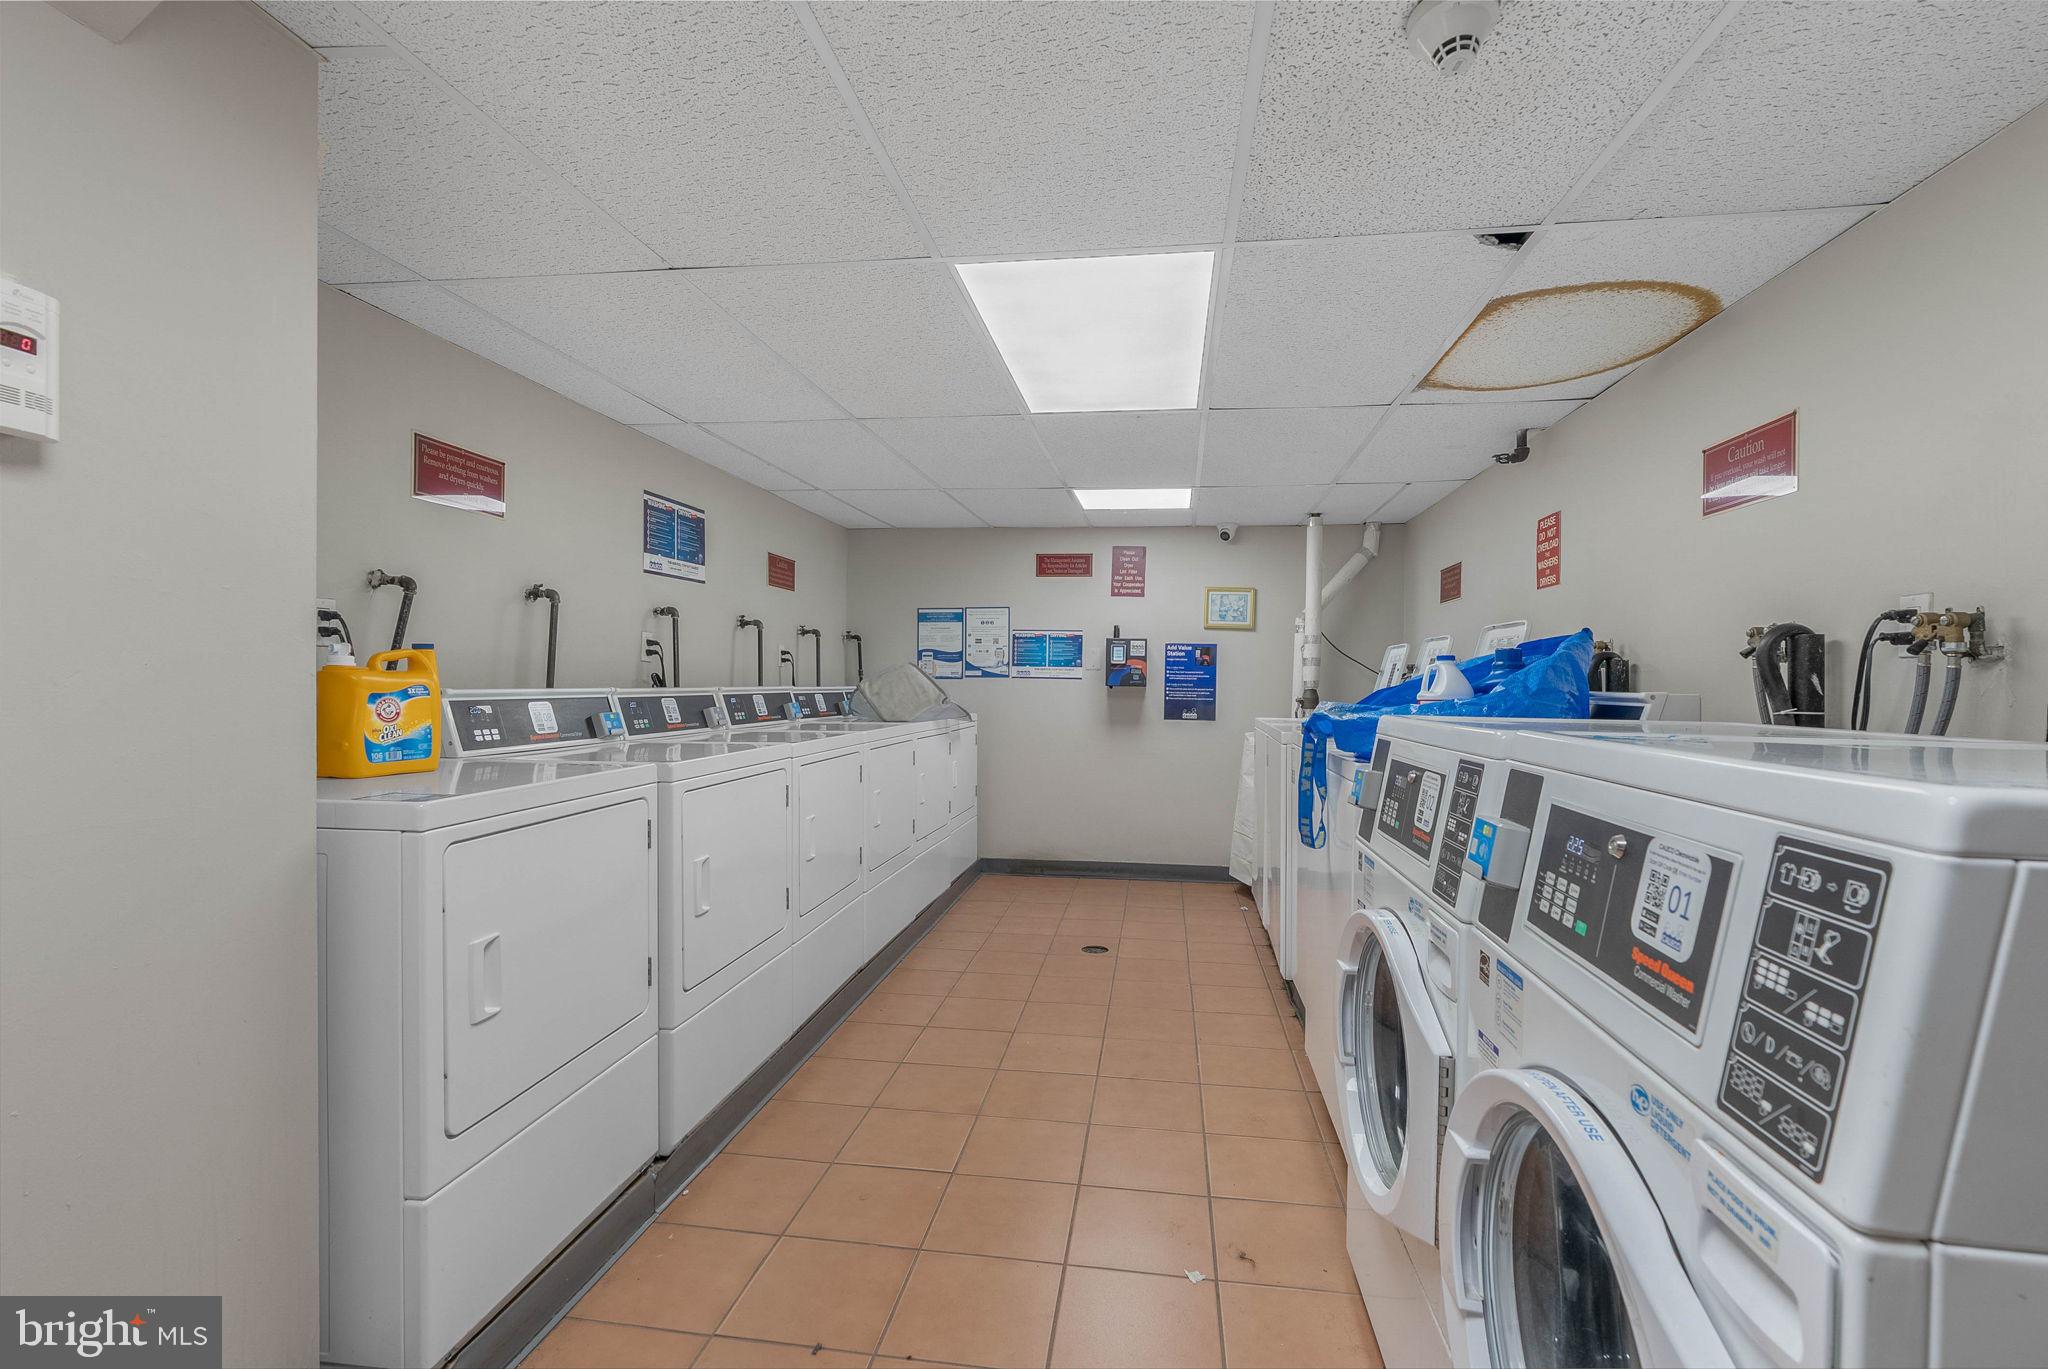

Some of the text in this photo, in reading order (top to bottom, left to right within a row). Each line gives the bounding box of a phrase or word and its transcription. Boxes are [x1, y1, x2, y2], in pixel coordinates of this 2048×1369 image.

[21, 338, 30, 350] 0
[422, 444, 438, 456] Please
[440, 450, 446, 458] be
[447, 454, 466, 466] prompt
[466, 459, 476, 468] and
[1728, 440, 1764, 462] Caution
[424, 455, 498, 484] Remove clothing from washers
[438, 472, 448, 480] and
[450, 476, 465, 486] dryers
[1540, 516, 1556, 530] PLEASE
[1538, 538, 1558, 553] OVERLOAD
[1539, 527, 1556, 542] DO NOT
[1538, 556, 1558, 570] WASHERS
[1540, 574, 1556, 587] DRYERS
[380, 729, 402, 741] CLEAN
[383, 724, 397, 734] OXI
[1668, 884, 1692, 922] 01
[1632, 946, 1694, 994] Speed Queen
[1634, 965, 1692, 1009] Commercial Washer
[1552, 1088, 1586, 1117] AFTER
[1579, 1120, 1604, 1142] USE
[1651, 1095, 1684, 1128] USE ONLY
[1651, 1106, 1674, 1132] LIQUID
[1651, 1118, 1692, 1162] DETERGENT
